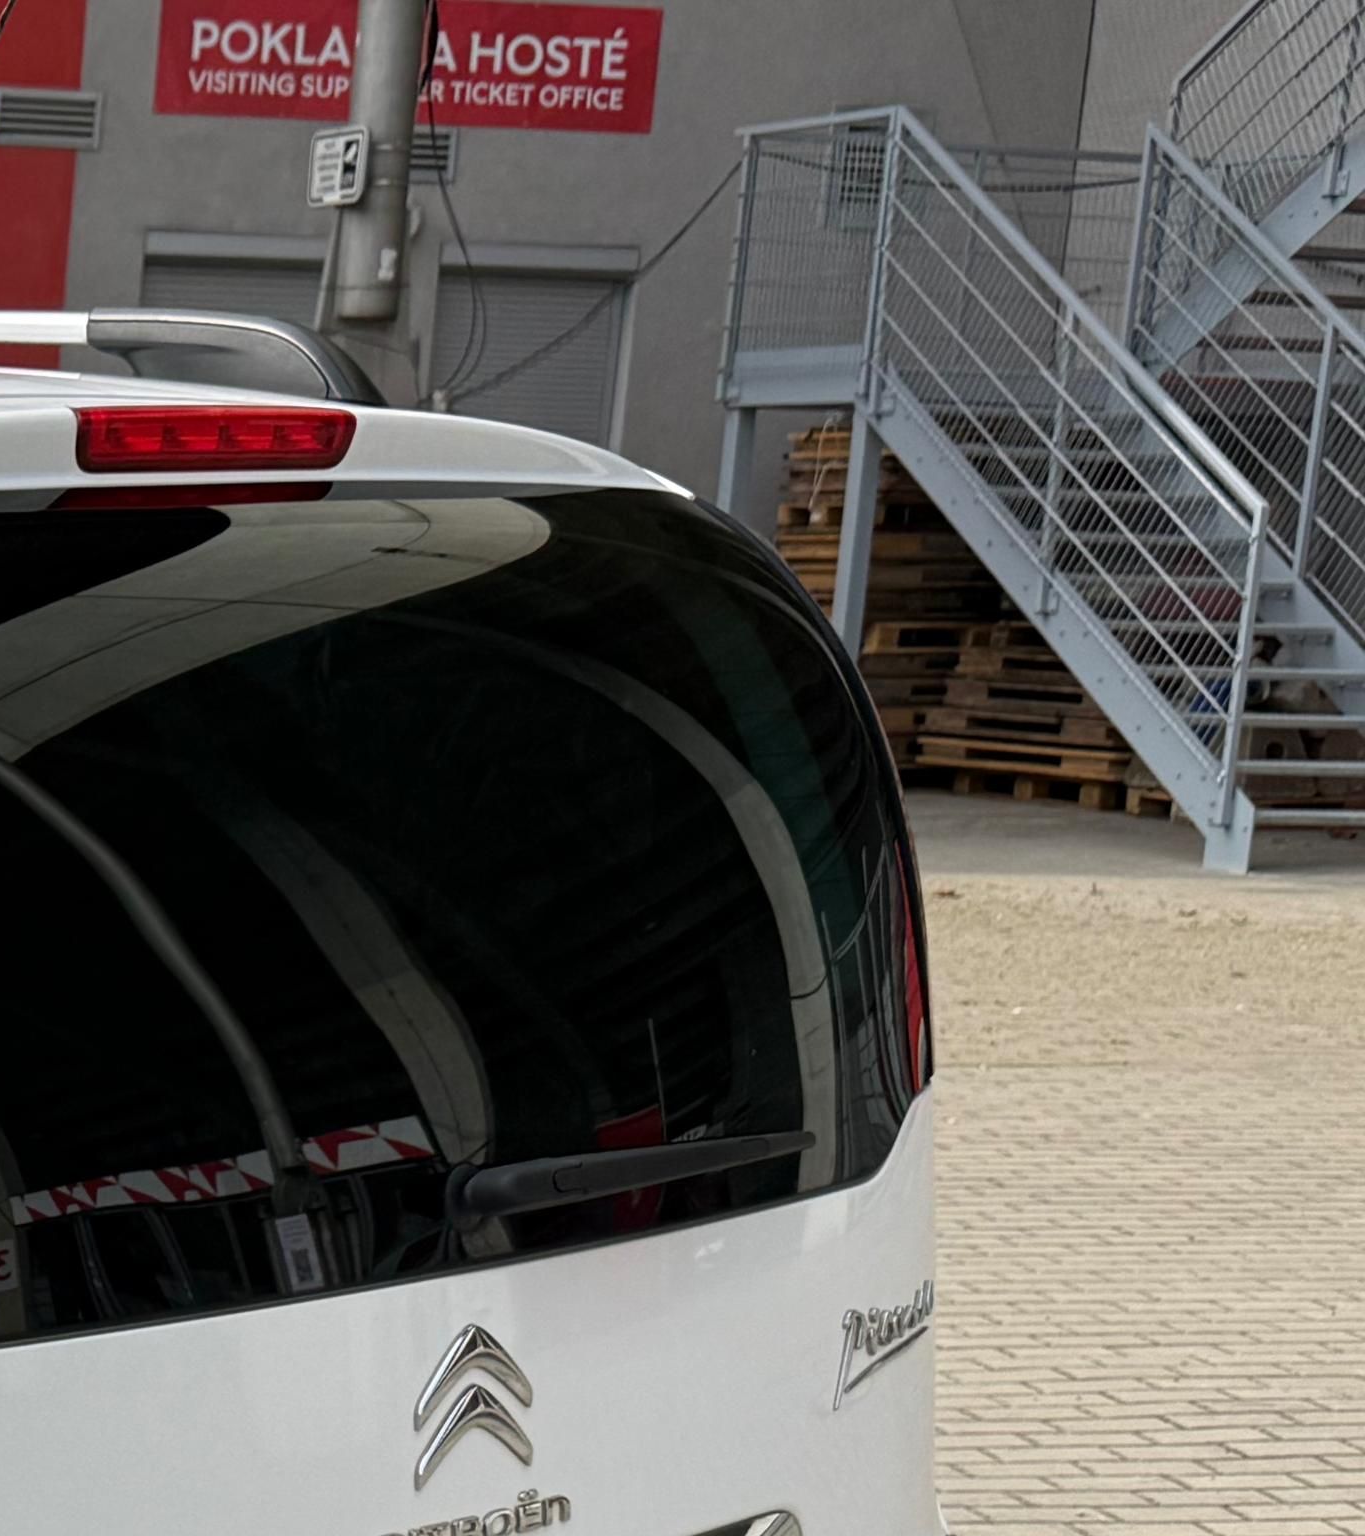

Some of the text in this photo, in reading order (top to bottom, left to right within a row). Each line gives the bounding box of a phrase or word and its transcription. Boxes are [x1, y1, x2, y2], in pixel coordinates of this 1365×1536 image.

[191, 19, 628, 79] POKLAA HOSTÉ
[189, 68, 296, 97] VISITING
[451, 79, 535, 107] TICKET
[538, 84, 624, 110] OFFICE
